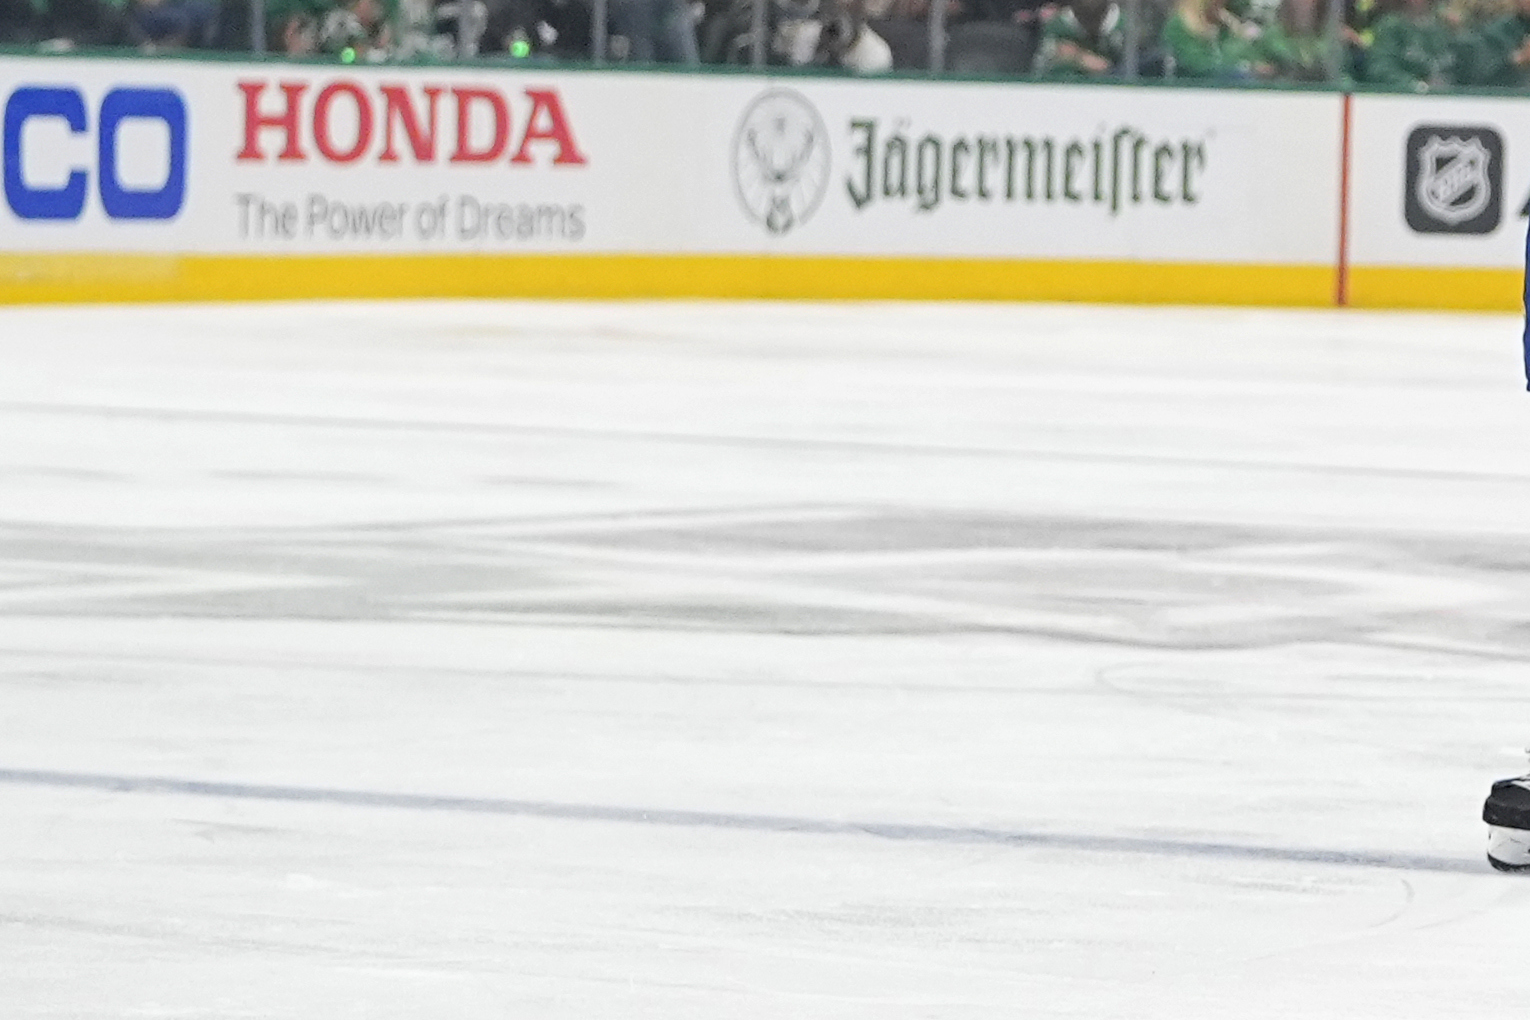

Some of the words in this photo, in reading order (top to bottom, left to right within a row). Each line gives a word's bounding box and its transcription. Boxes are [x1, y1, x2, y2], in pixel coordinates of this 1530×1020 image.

[3, 86, 188, 221] CO
[236, 80, 588, 166] HONDA
[236, 192, 298, 240] The
[306, 192, 408, 240] Power
[415, 193, 450, 240] of
[457, 194, 587, 241] Dreams
